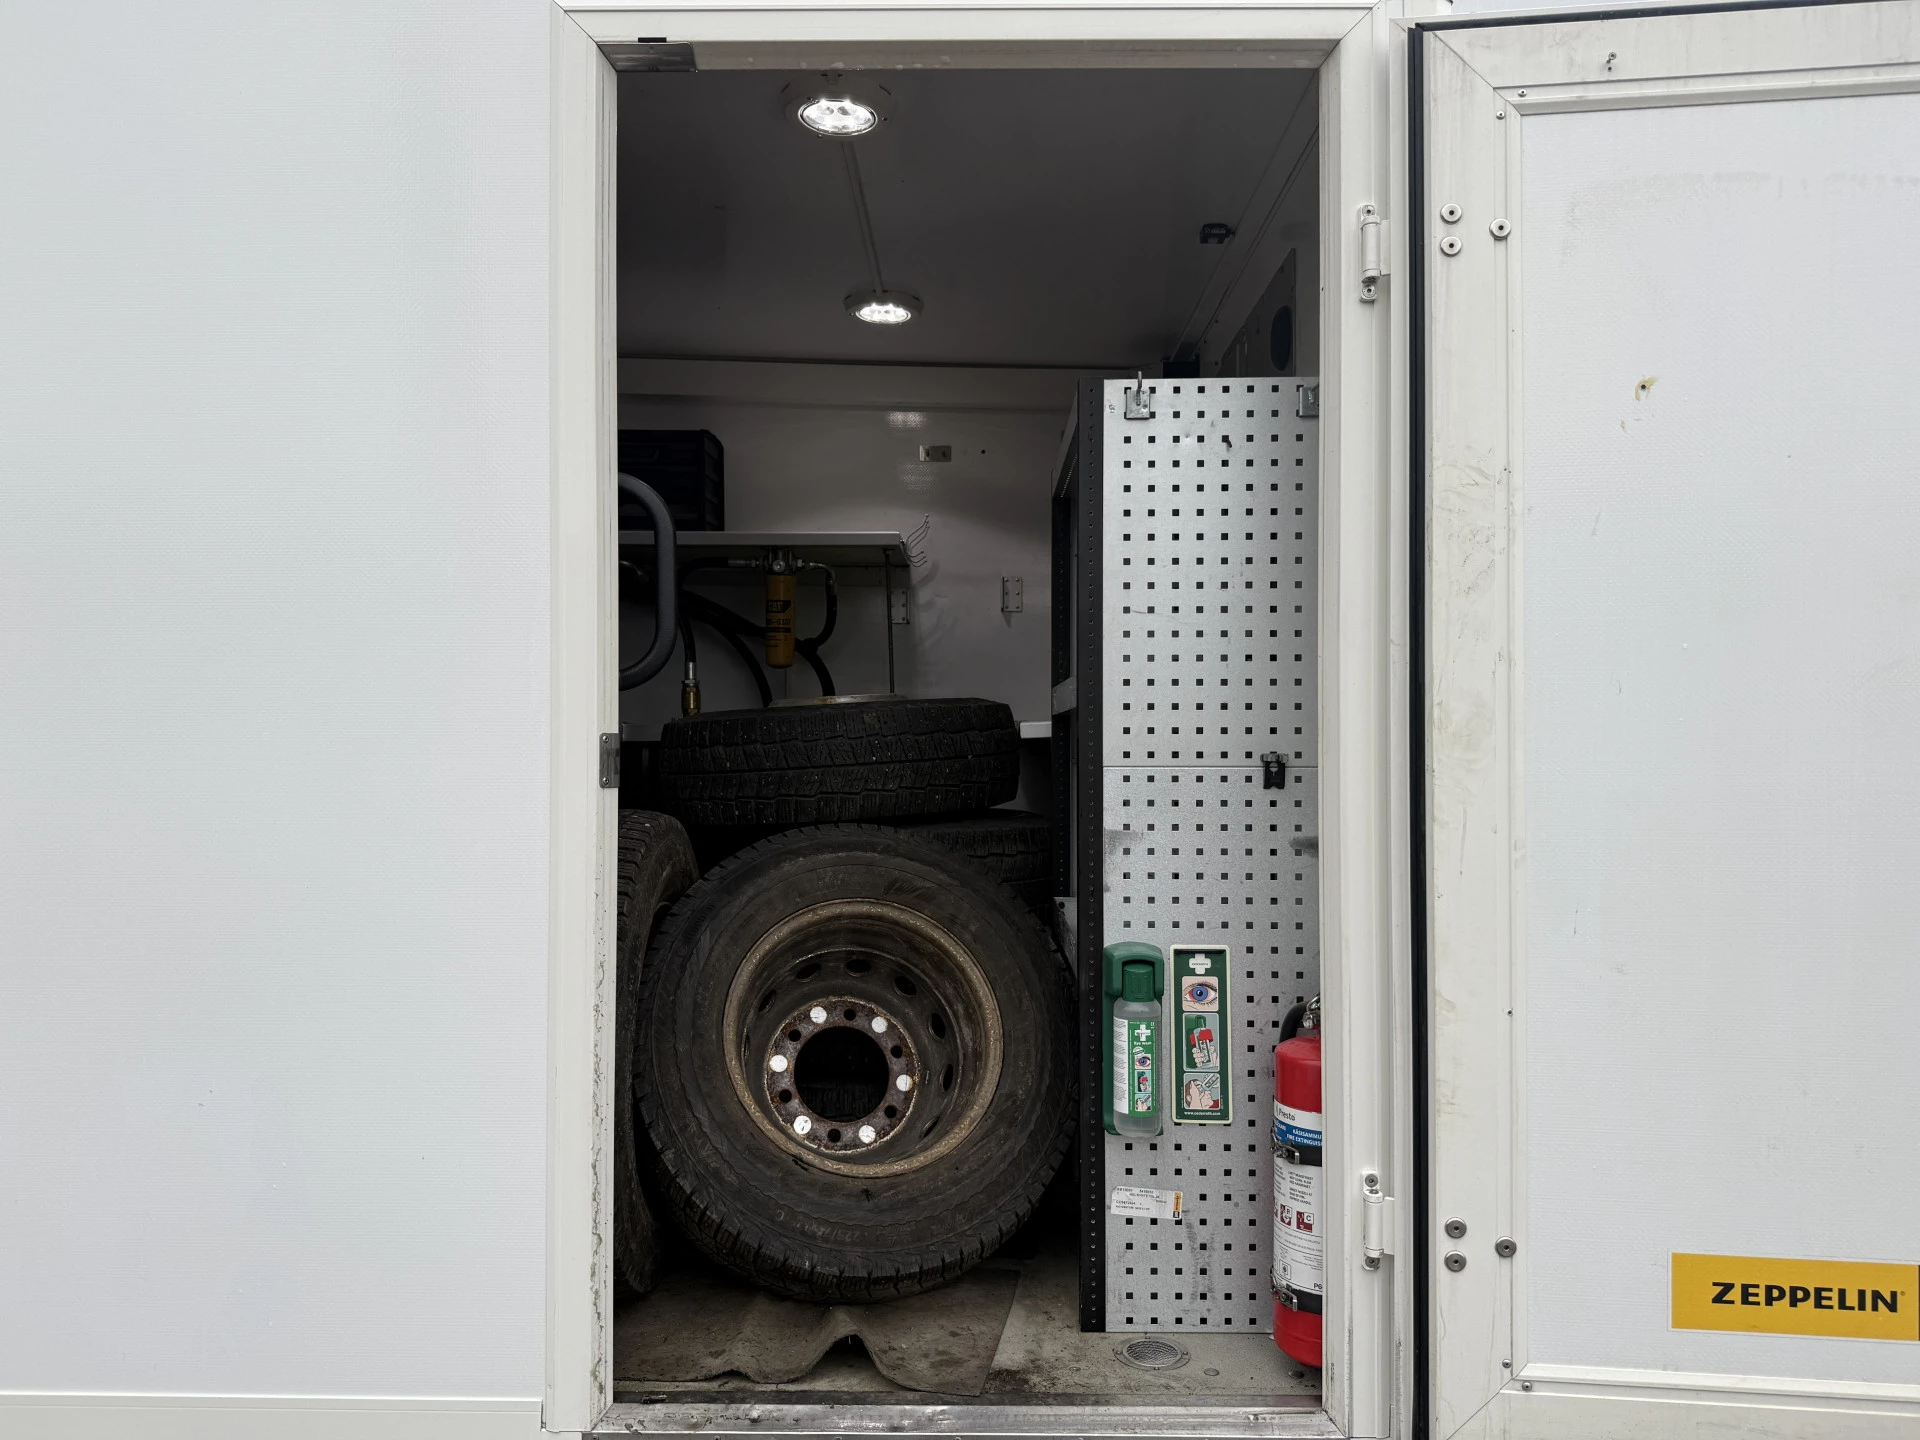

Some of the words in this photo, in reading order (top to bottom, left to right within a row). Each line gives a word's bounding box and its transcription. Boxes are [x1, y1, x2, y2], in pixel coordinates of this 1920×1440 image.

[1279, 1107, 1296, 1121] Presto
[1295, 1136, 1322, 1147] EXTINGUIS
[1711, 1281, 1898, 1313] ZEPPELIN
